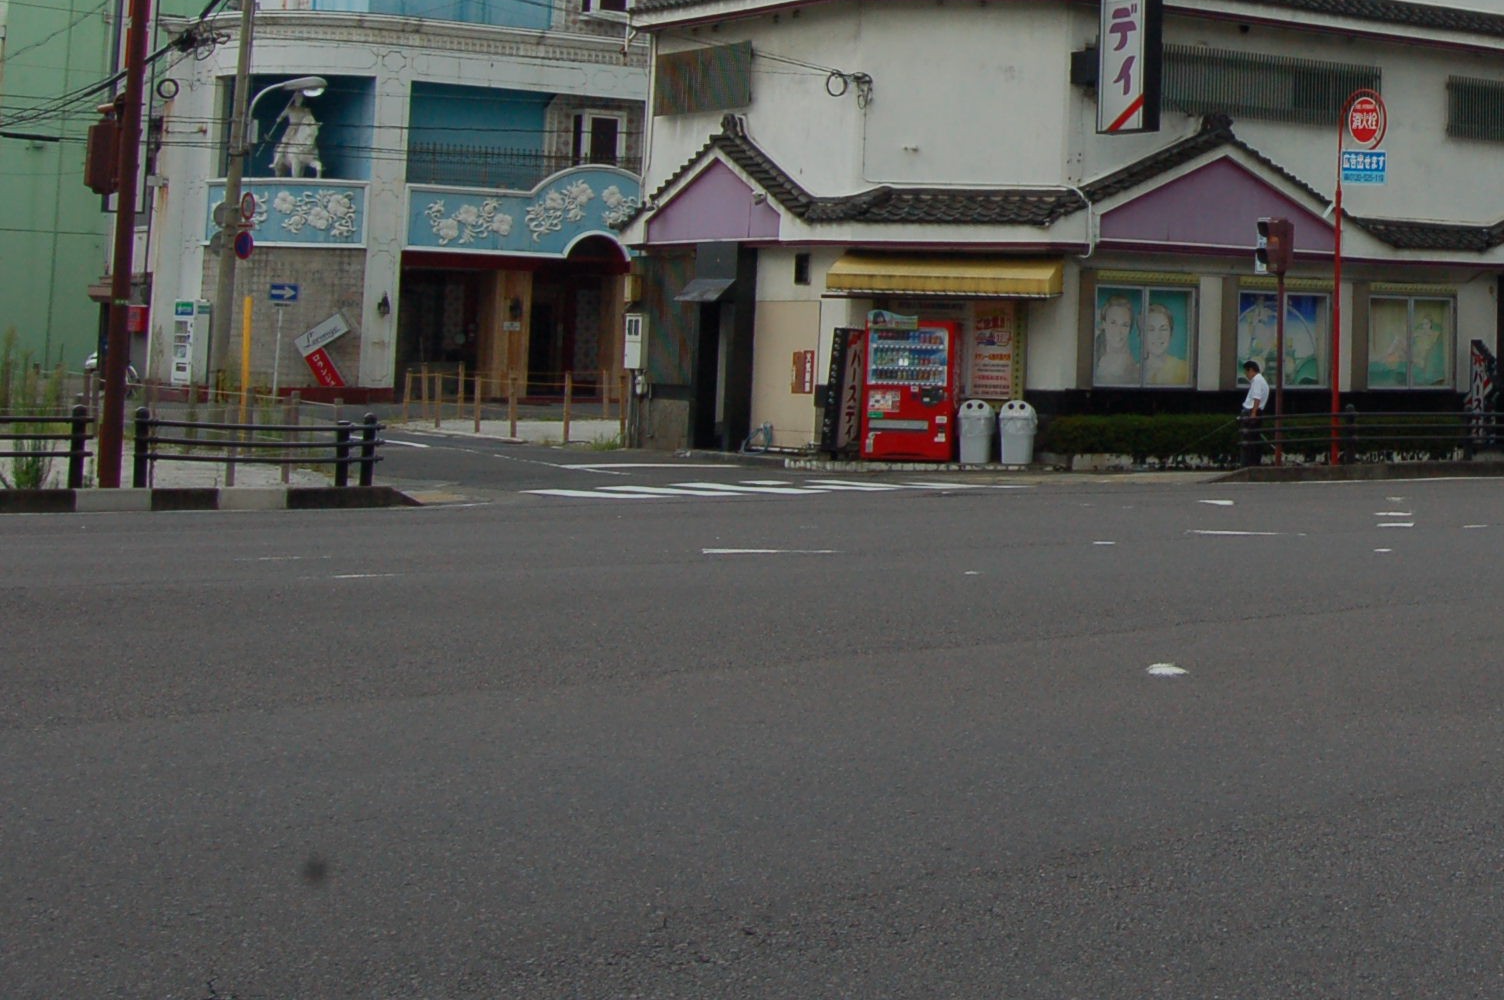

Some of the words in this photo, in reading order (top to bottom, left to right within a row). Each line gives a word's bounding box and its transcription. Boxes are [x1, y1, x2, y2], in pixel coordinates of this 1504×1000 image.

[1352, 112, 1378, 130] 消火栓
[1342, 153, 1385, 171] 広告出せます
